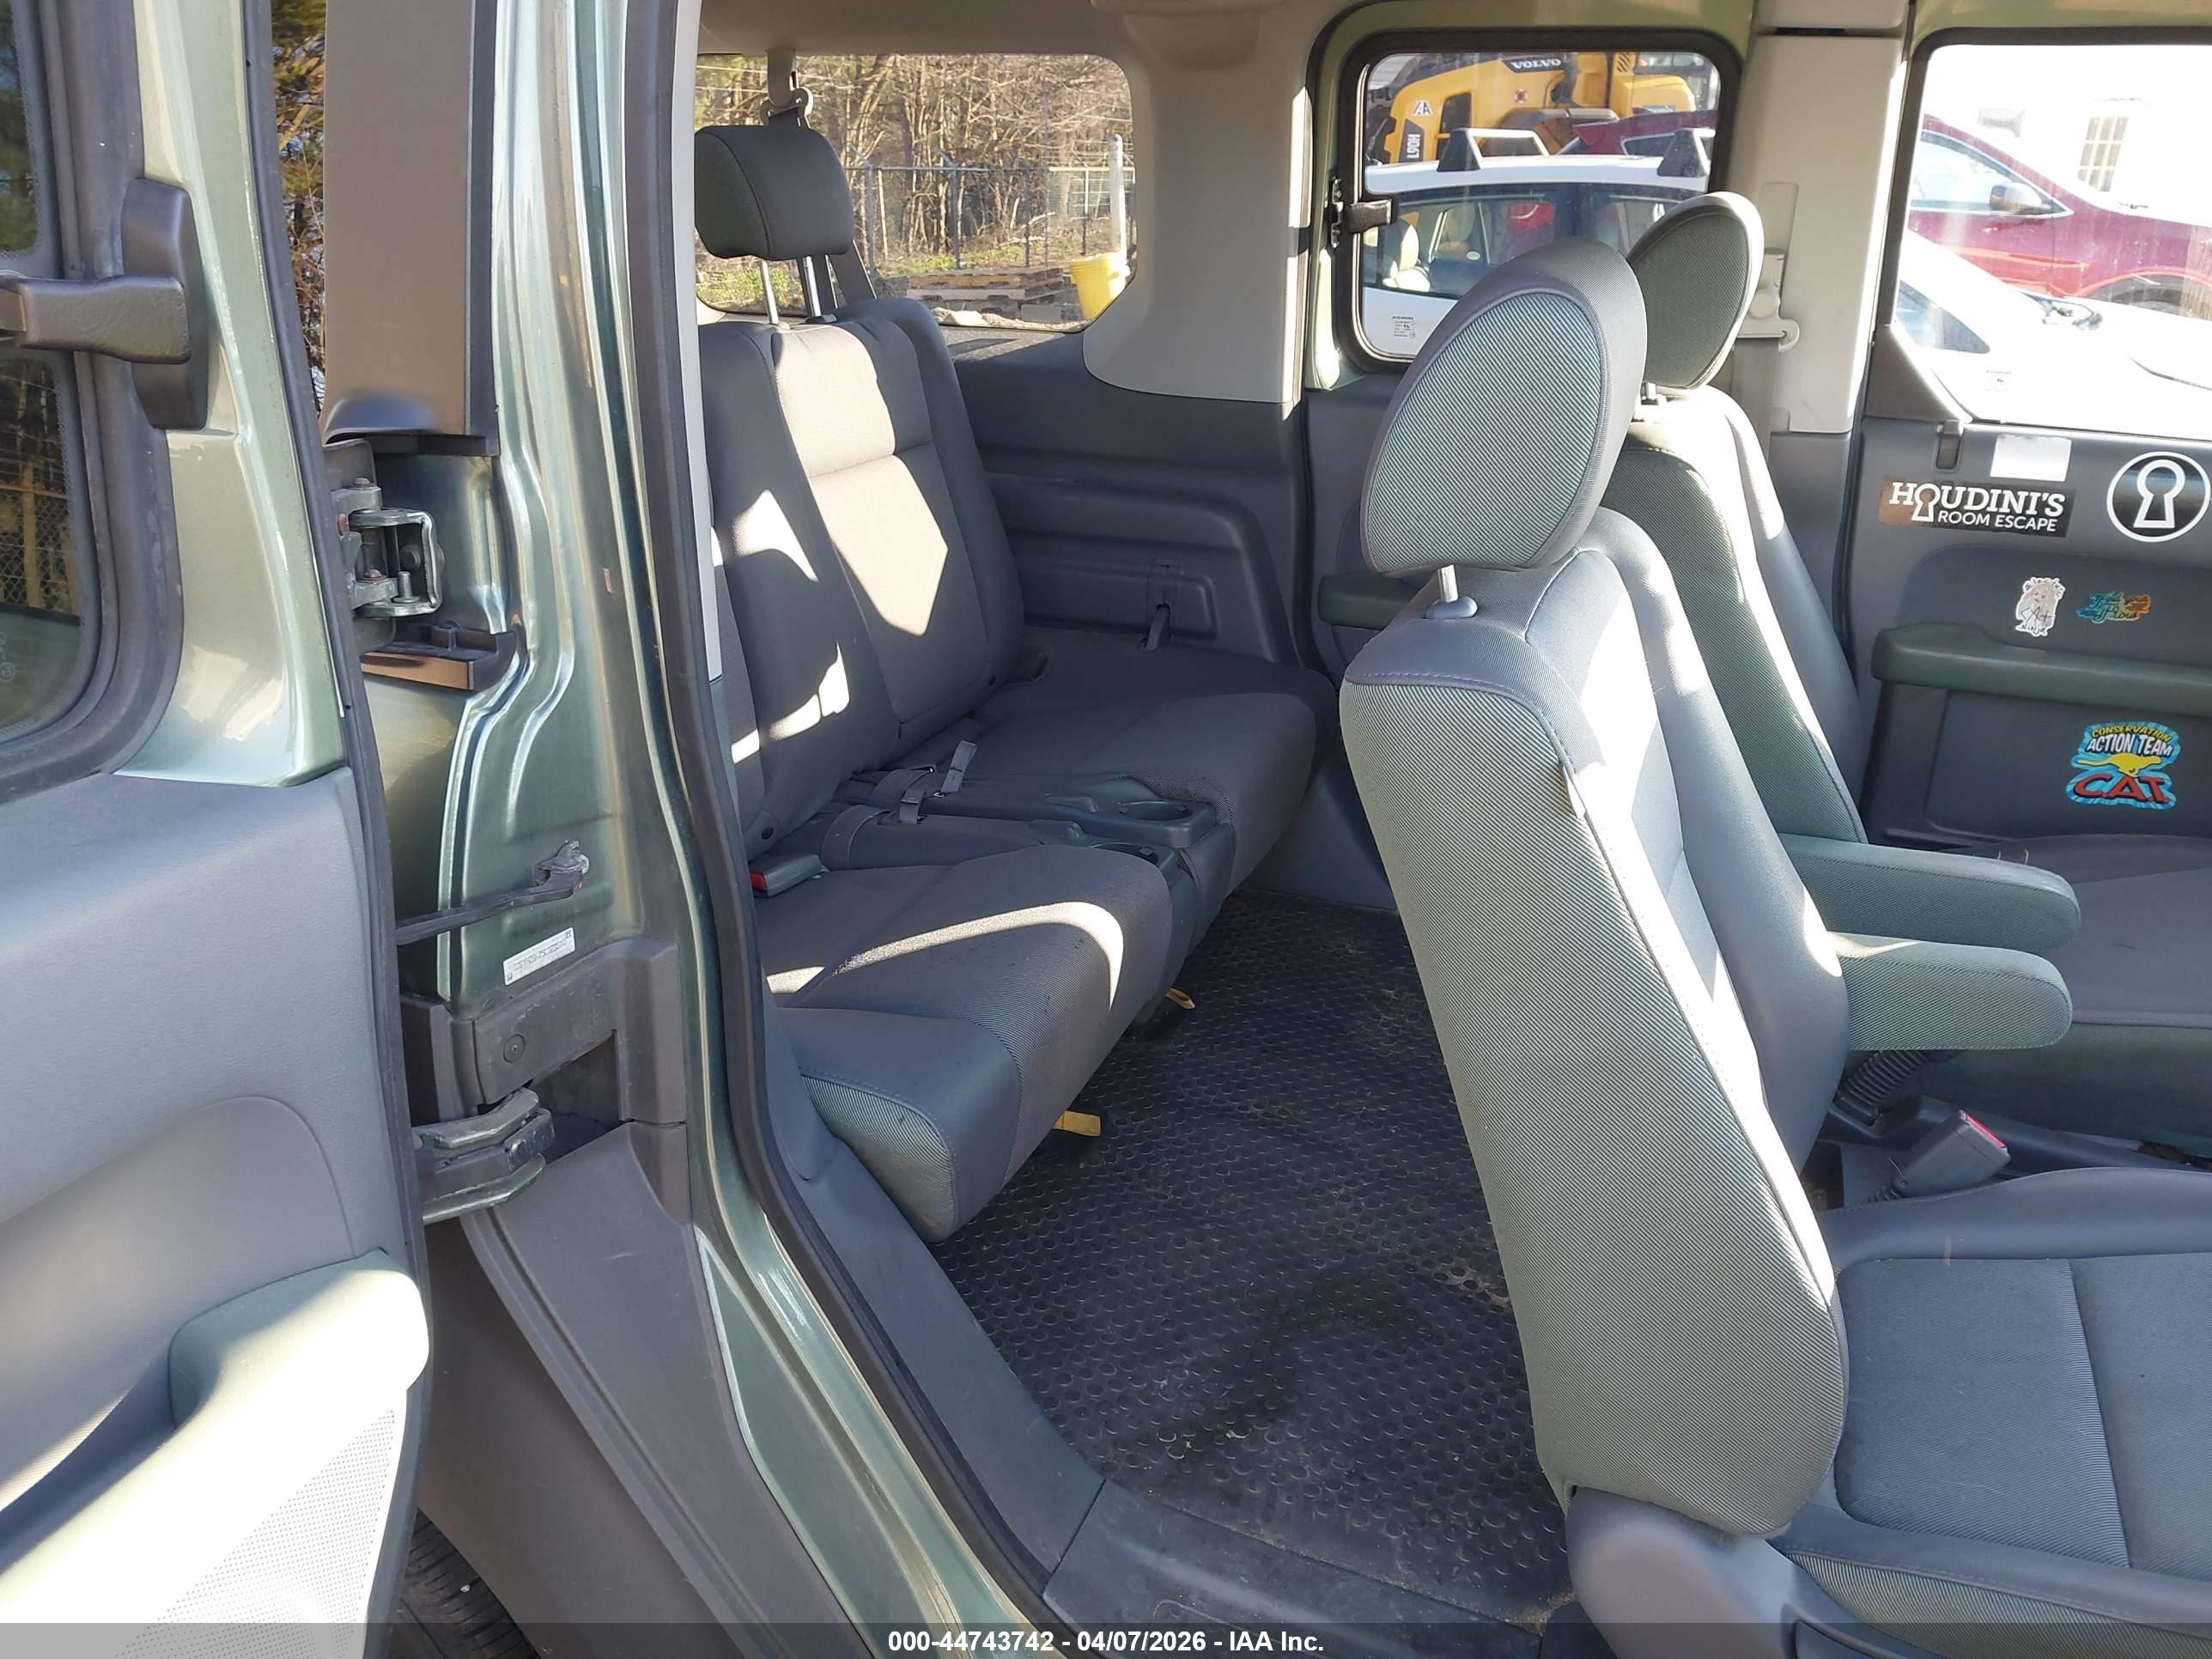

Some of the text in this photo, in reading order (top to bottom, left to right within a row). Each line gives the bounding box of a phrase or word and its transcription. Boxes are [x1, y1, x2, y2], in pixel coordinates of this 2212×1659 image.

[1511, 58, 1562, 70] VOLVO
[1407, 134, 1421, 159] L90H
[1889, 482, 2066, 523] HOUDINI'S
[1938, 510, 2057, 532] ROOM ESCAPE
[2086, 733, 2173, 757] ACTION TEAM
[2092, 726, 2172, 743] CONSERVATION
